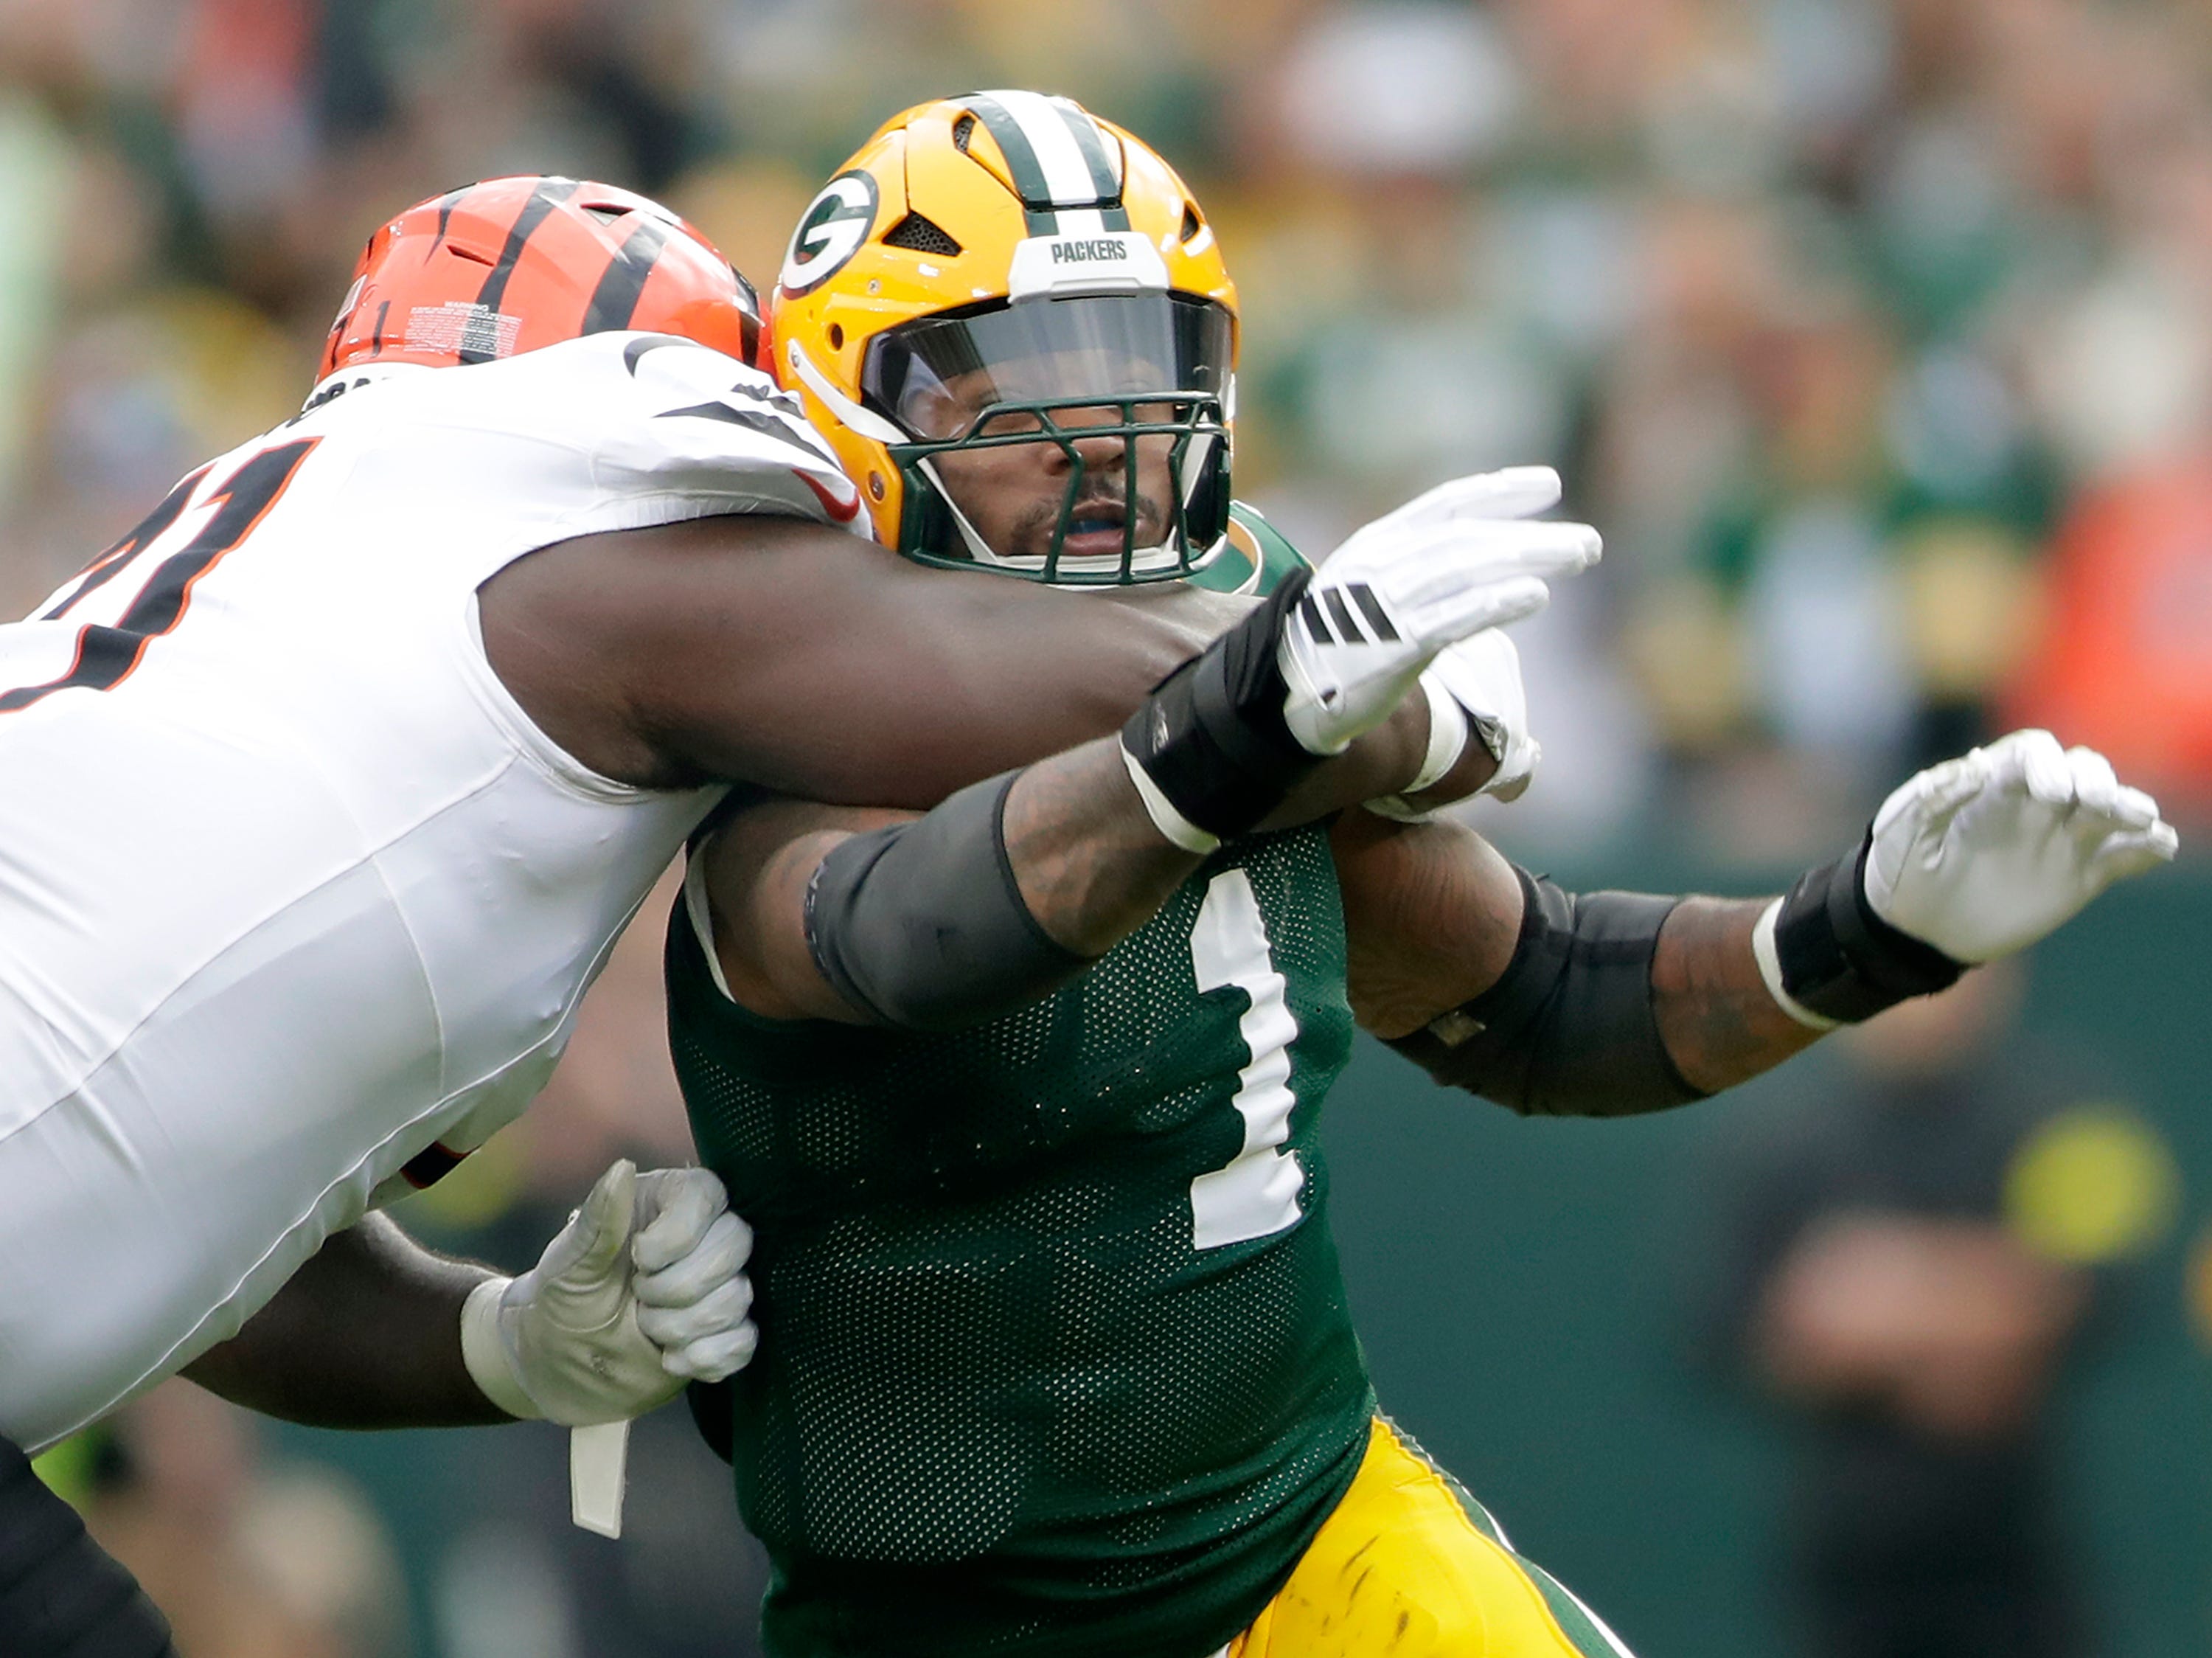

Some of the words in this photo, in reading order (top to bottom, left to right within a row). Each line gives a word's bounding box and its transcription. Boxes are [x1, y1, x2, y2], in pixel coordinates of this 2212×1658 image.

[782, 175, 873, 291] G
[1051, 240, 1127, 263] PACKERS
[1190, 867, 1304, 1251] 1
